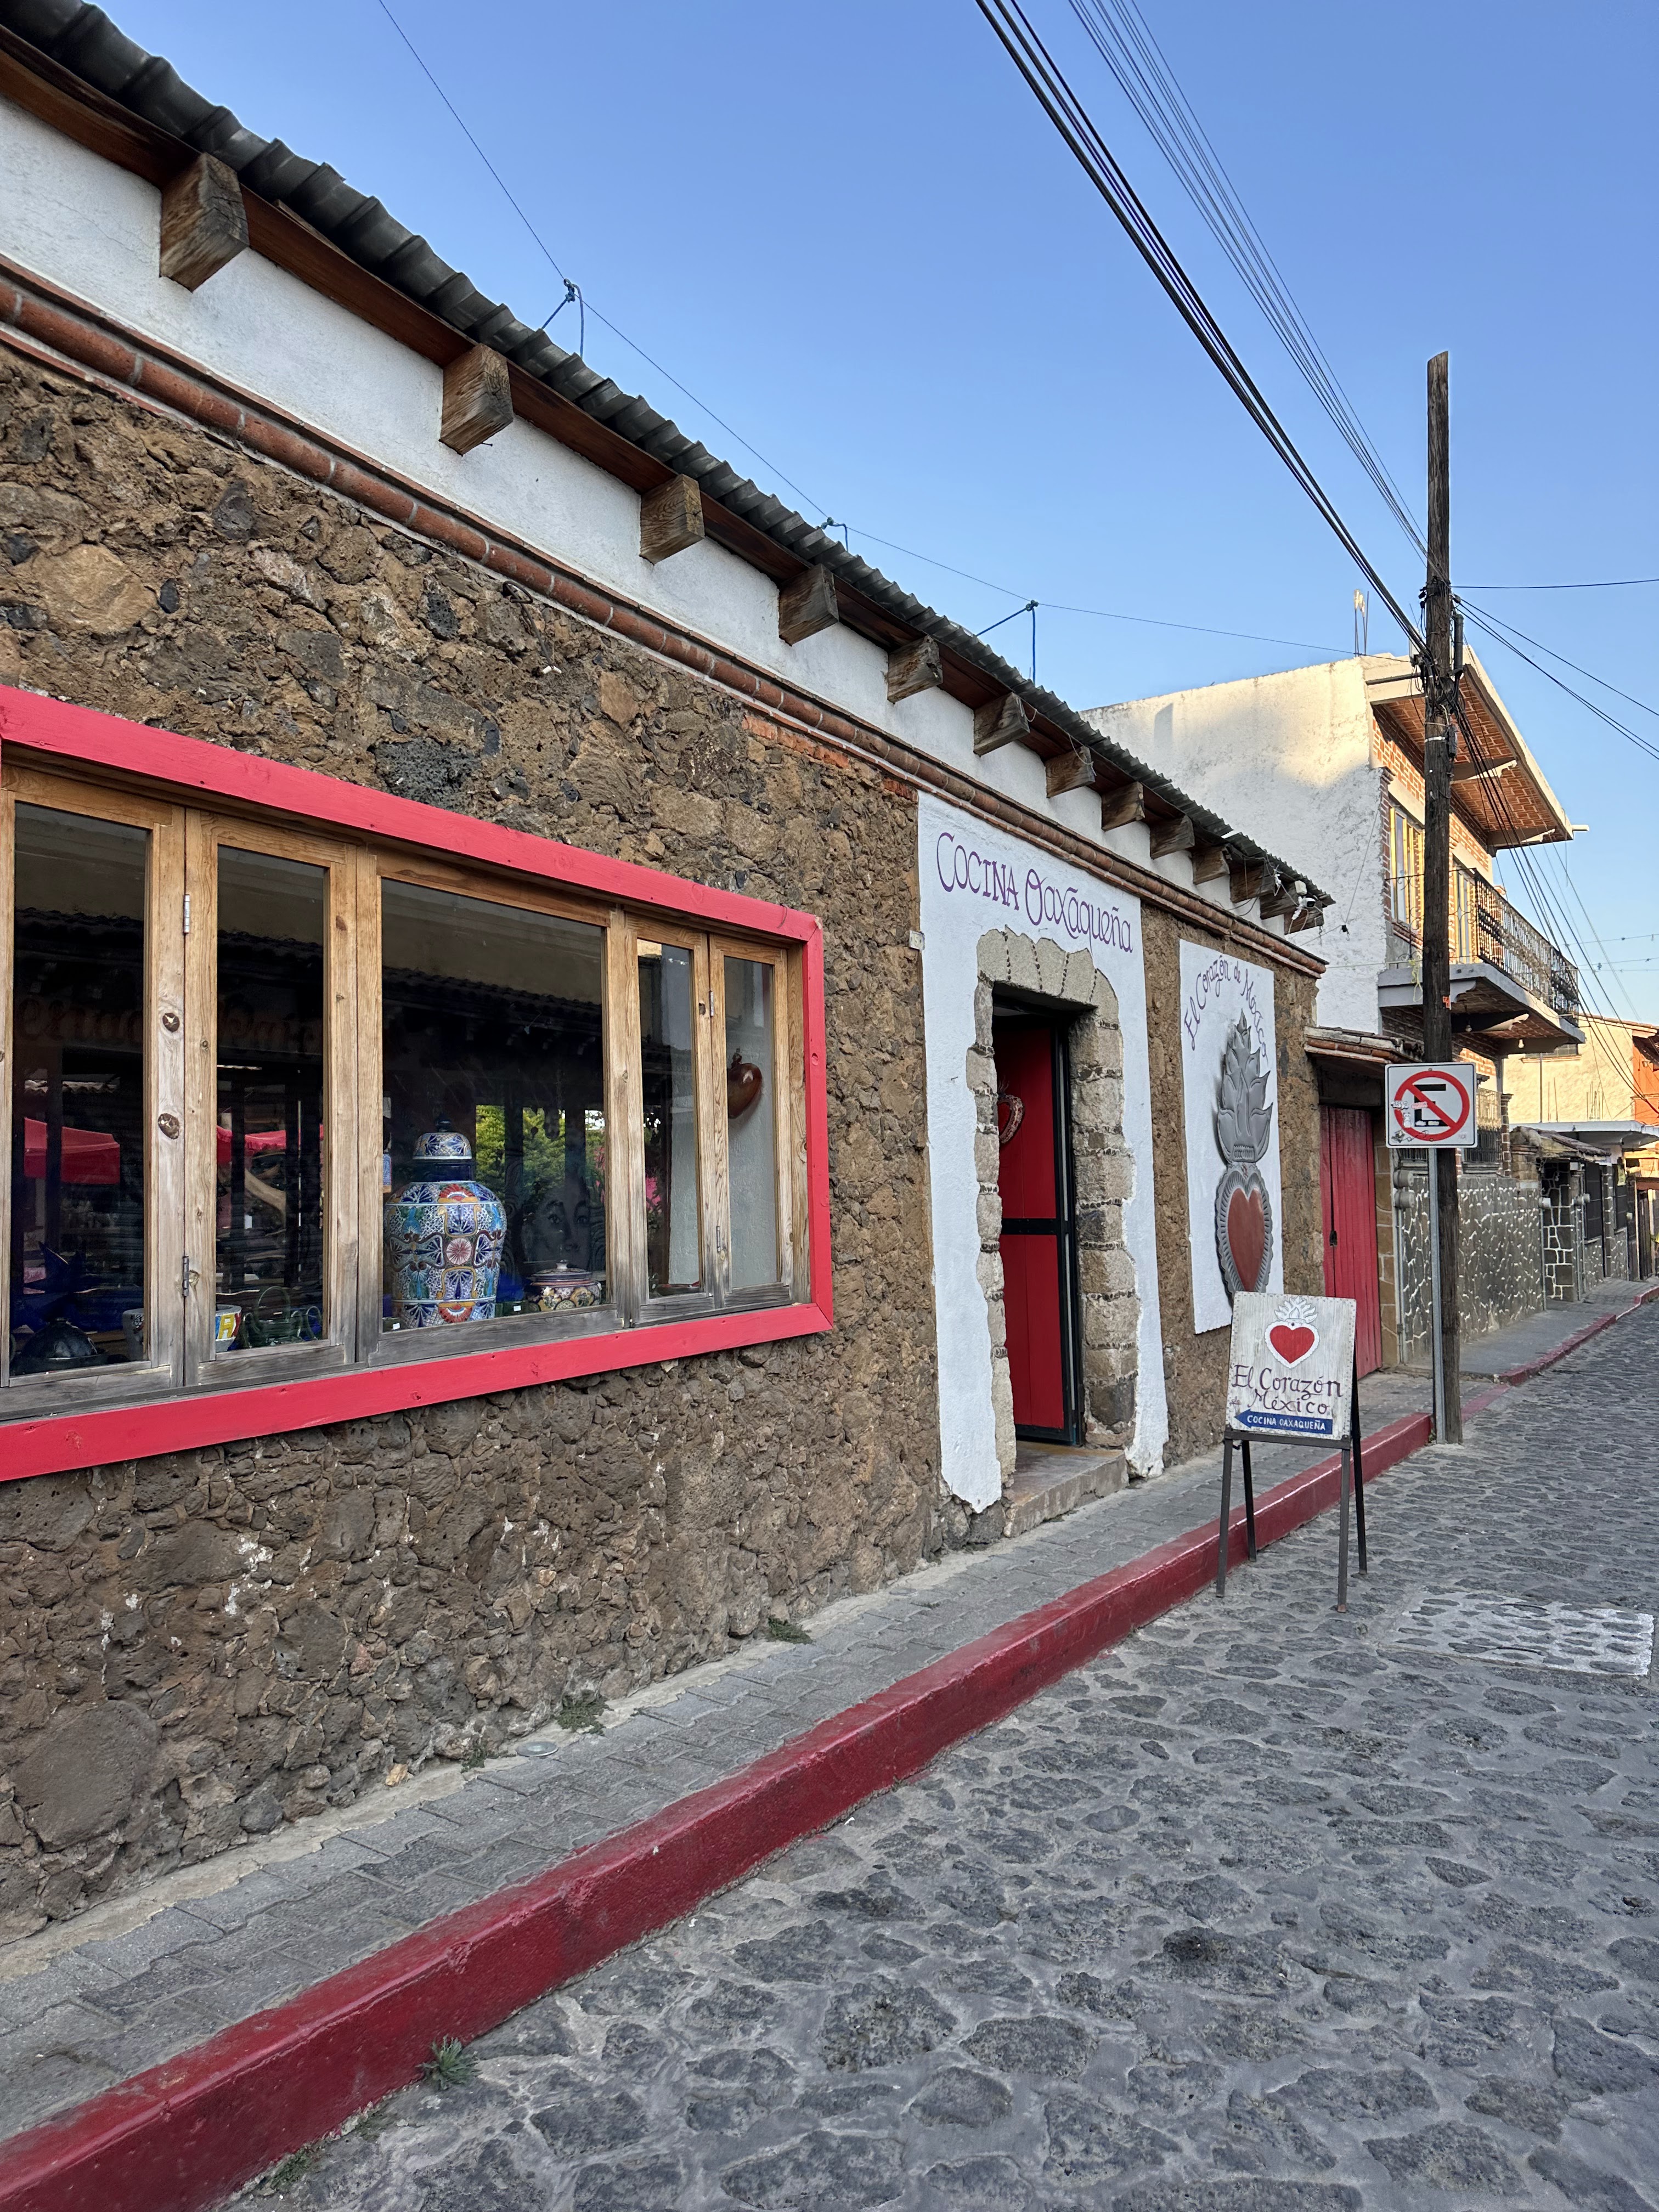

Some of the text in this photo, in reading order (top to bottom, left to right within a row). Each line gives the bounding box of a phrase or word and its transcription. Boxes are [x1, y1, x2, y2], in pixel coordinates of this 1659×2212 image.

[1025, 868, 1133, 955] Oaxaqueña
[1184, 955, 1269, 1066] El Corazón de México
[1414, 1084, 1448, 1127] E
[1232, 1364, 1343, 1400] El Corazón
[1247, 1388, 1329, 1414] México
[1247, 1415, 1325, 1430] COCINA OAXAQUEÑA
